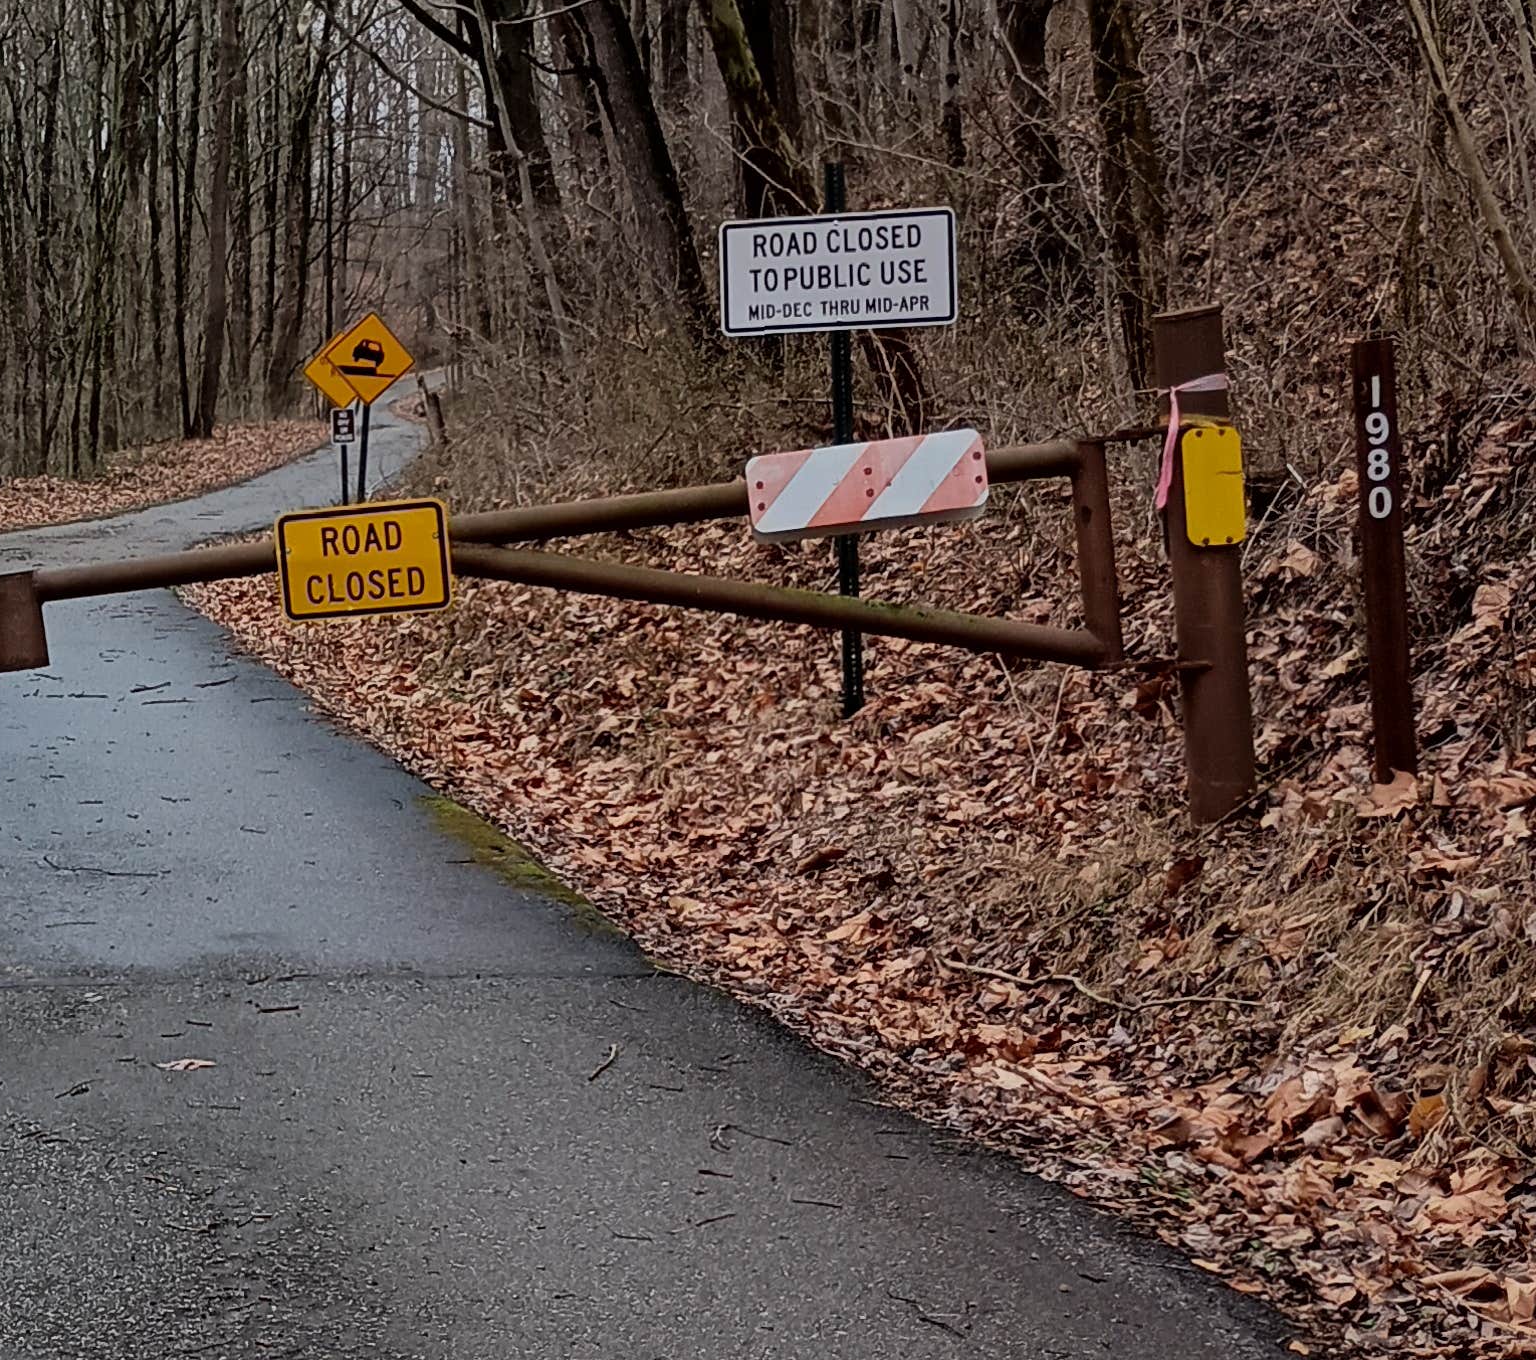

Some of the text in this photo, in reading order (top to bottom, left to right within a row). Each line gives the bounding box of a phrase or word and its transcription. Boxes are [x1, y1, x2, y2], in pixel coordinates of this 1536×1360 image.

[753, 224, 922, 258] ROAD CLOSED
[749, 259, 928, 293] TO PUBLIC USE
[748, 296, 930, 321] MID-DEC THRU MID-APR
[1365, 374, 1392, 519] 1980
[321, 520, 402, 557] ROAD
[307, 566, 425, 605] CLOSED
